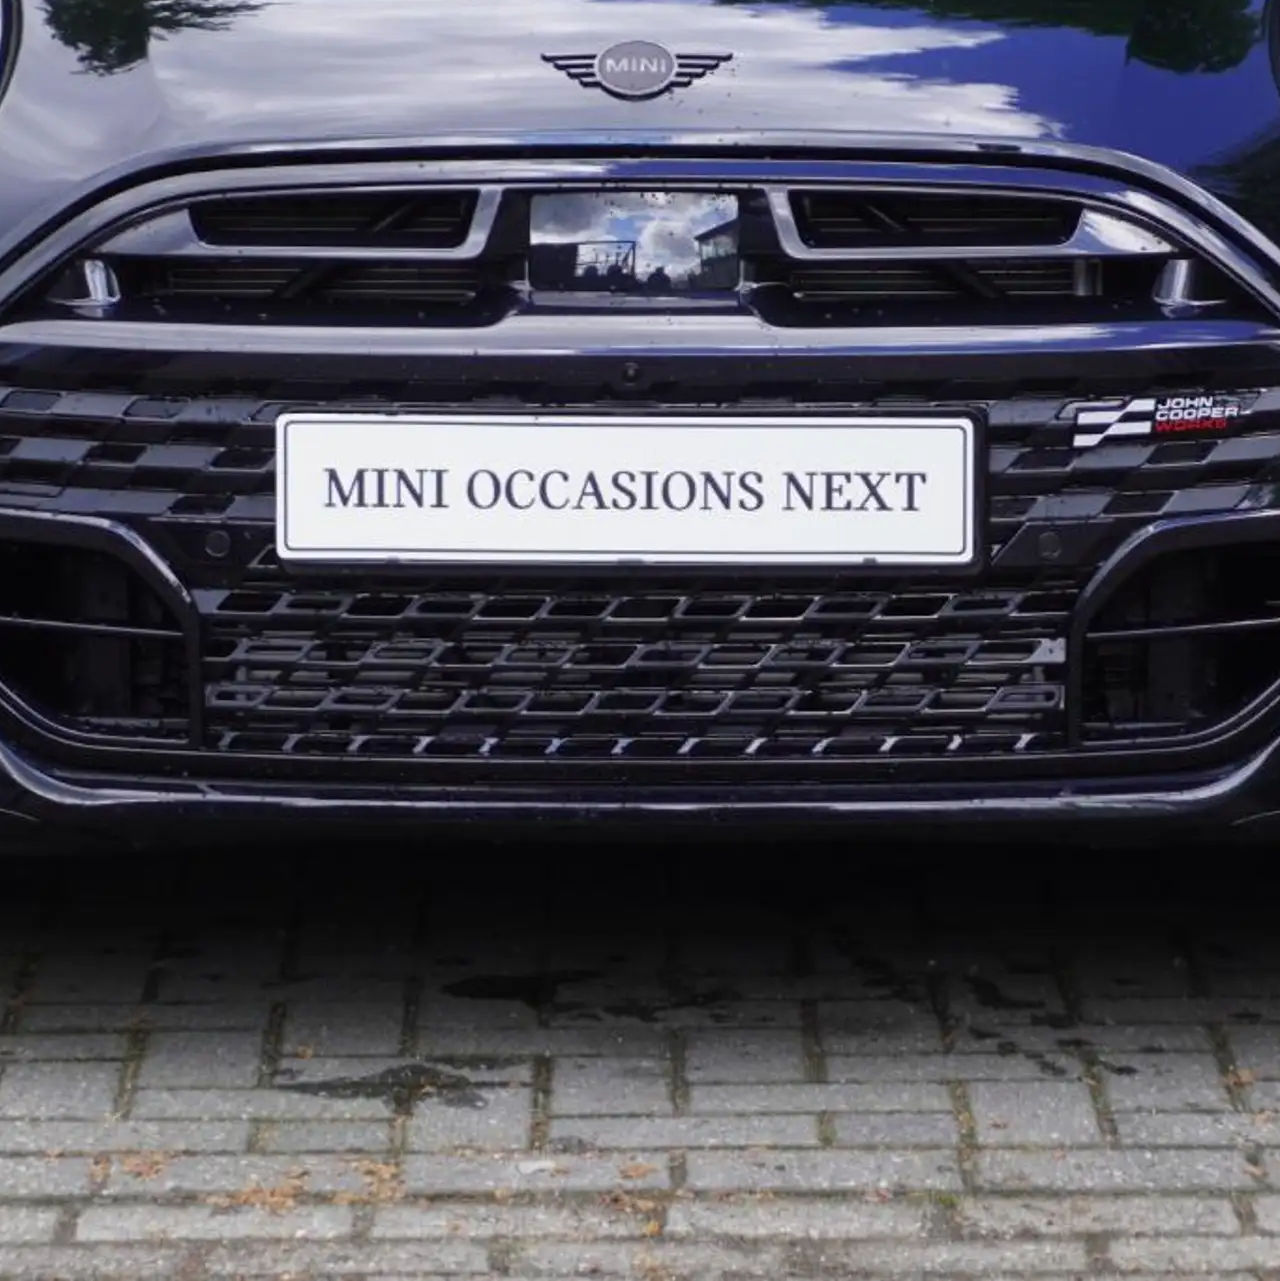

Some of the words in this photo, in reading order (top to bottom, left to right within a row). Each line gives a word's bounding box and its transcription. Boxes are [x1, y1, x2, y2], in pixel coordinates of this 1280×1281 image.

[605, 57, 667, 73] MINI
[1157, 396, 1214, 409] JOHN
[1155, 407, 1239, 420] COOPER
[323, 467, 450, 509] MINI
[466, 467, 765, 511] OCCASIONS
[781, 470, 928, 512] NEXT
